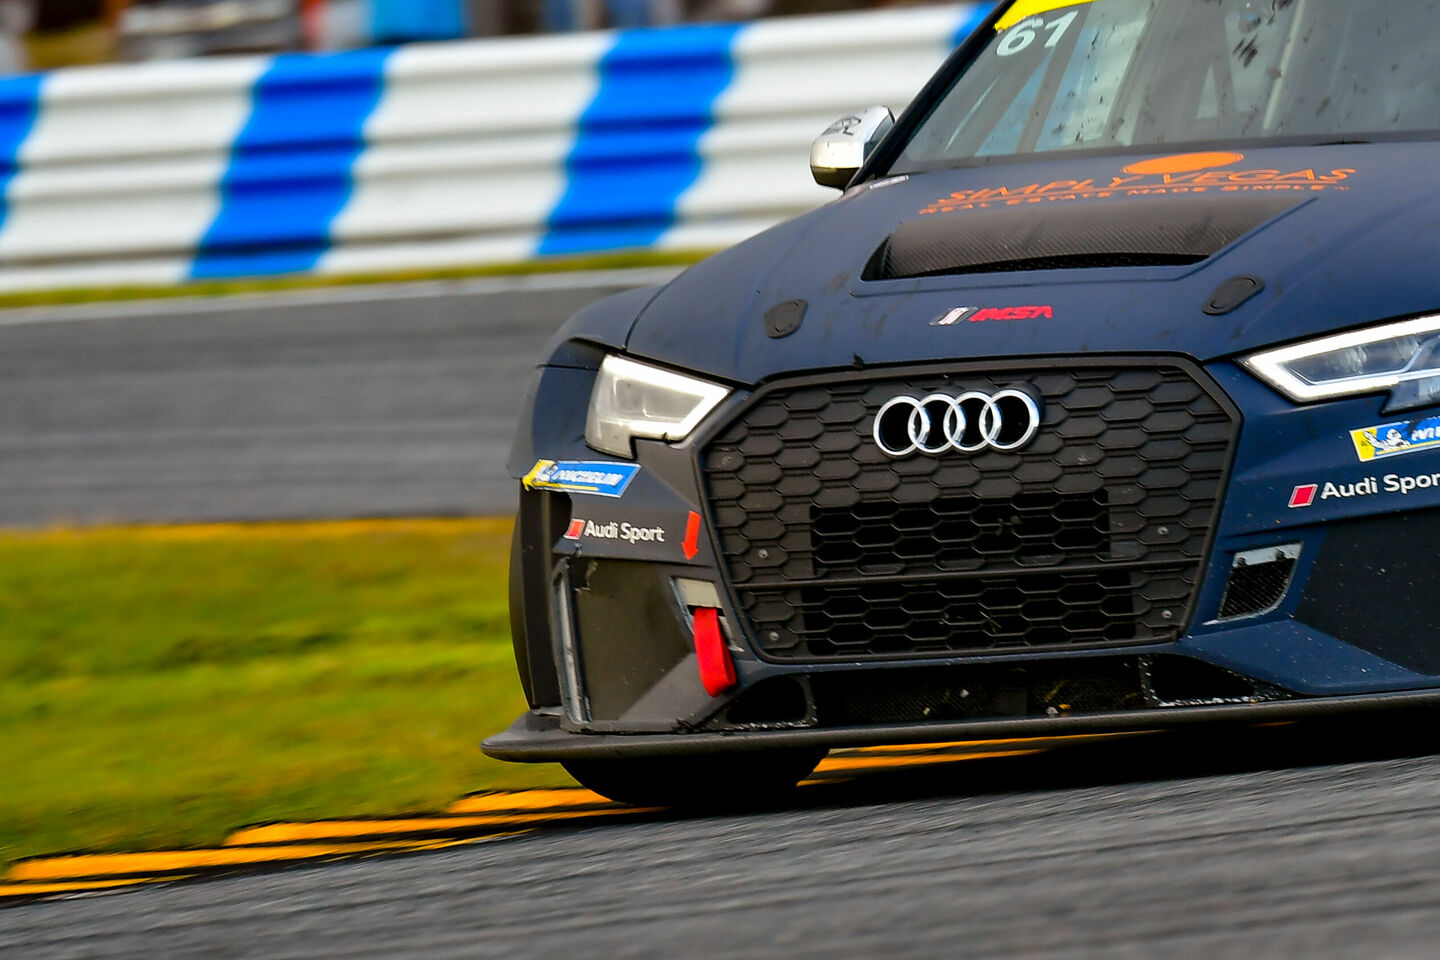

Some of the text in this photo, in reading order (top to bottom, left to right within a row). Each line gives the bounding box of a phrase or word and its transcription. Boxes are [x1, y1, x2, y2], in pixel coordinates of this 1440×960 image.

[996, 10, 1079, 56] 61
[936, 175, 1145, 207] SIMPLY
[1162, 169, 1357, 185] VEGAS
[553, 470, 624, 487] MICHELIN
[1320, 476, 1379, 500] Audi
[584, 520, 666, 545] Audi Sport
